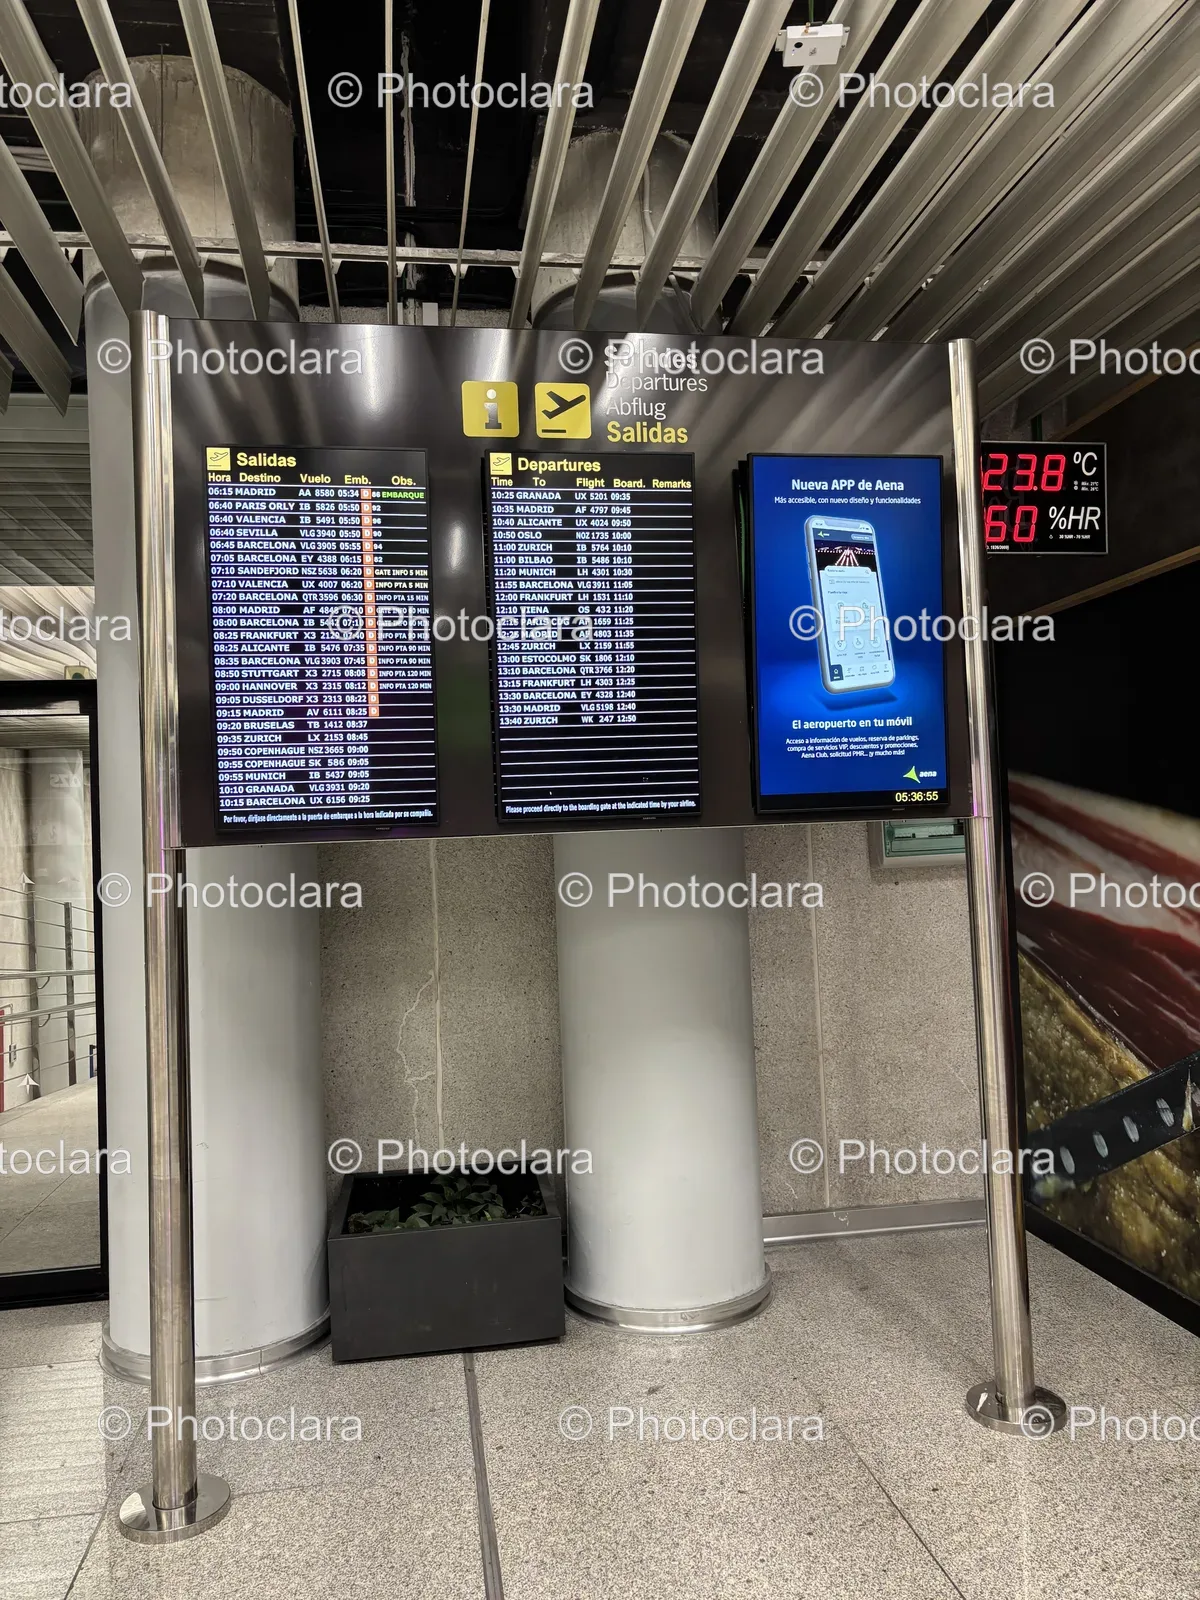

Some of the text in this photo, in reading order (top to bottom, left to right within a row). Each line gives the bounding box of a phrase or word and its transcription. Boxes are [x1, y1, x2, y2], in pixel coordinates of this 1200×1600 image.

[606, 371, 708, 393] Departures
[606, 397, 666, 420] Abflug
[607, 421, 688, 443] Salidas
[237, 452, 297, 467] Salidas
[518, 458, 601, 474] Departures
[983, 454, 1066, 491] 23.8
[208, 473, 416, 486] Hora Destino Vuelo Emb. Obs.
[491, 478, 691, 489] Time To Flight Board. Remarks
[792, 479, 904, 491] Nueva APP de Aena
[208, 488, 233, 496] 06:15
[235, 488, 276, 496] MADRID
[299, 489, 311, 497] AA
[315, 489, 334, 498] 8580
[338, 490, 359, 498] 05:34
[492, 492, 514, 500] 10:25
[516, 492, 561, 500] GRANADA
[590, 493, 608, 501] 5201
[611, 493, 630, 501] 09:35
[209, 502, 233, 510] 06:40
[235, 502, 266, 510] PARIS
[268, 503, 295, 511] ORLY
[299, 503, 310, 511] IB
[316, 503, 335, 511] 5826
[339, 504, 359, 512] 05:50
[986, 506, 1101, 542] 60 %HR
[518, 544, 552, 552] ZURICH
[576, 544, 587, 552] IB
[591, 544, 609, 552] 5764
[211, 555, 234, 563] 07:05
[237, 555, 296, 563] BARCELONA
[301, 555, 313, 563] EY
[317, 555, 337, 563] 4388
[340, 555, 361, 563] 06:15
[214, 644, 238, 652] 08:25
[241, 644, 290, 652] ALICANTE
[498, 655, 520, 663] 13:00
[522, 655, 576, 663] ESTOCOLMO
[615, 654, 634, 662] 12:10
[499, 692, 521, 700] 13:30
[217, 720, 367, 730] 09:20 BRUSELAS TB 1412 08:37
[500, 717, 522, 725] 13:40
[524, 716, 558, 724] ZURICH
[792, 716, 912, 730] El aeropuerto en tu móvil
[220, 795, 370, 807] 10:15 BARCELONA UX 6156 09:25
[895, 791, 938, 802] 05:36:55
